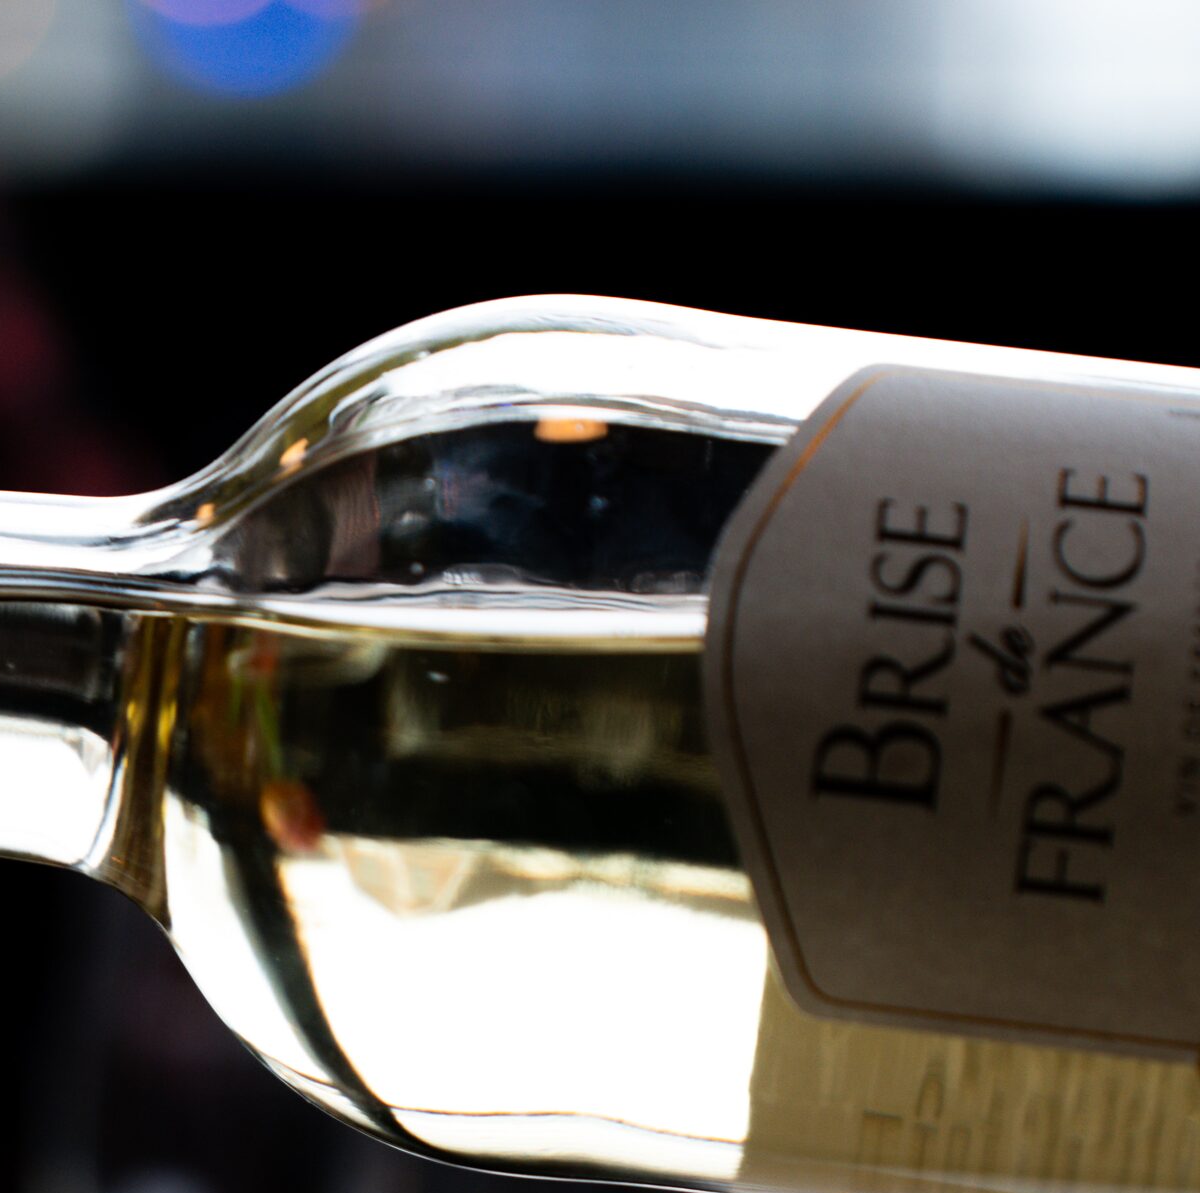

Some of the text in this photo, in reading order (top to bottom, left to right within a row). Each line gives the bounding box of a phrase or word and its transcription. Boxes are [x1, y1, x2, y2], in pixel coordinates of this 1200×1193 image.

[811, 499, 968, 815] BRISE
[967, 625, 1034, 695] de
[1014, 467, 1150, 905] FRANCE
